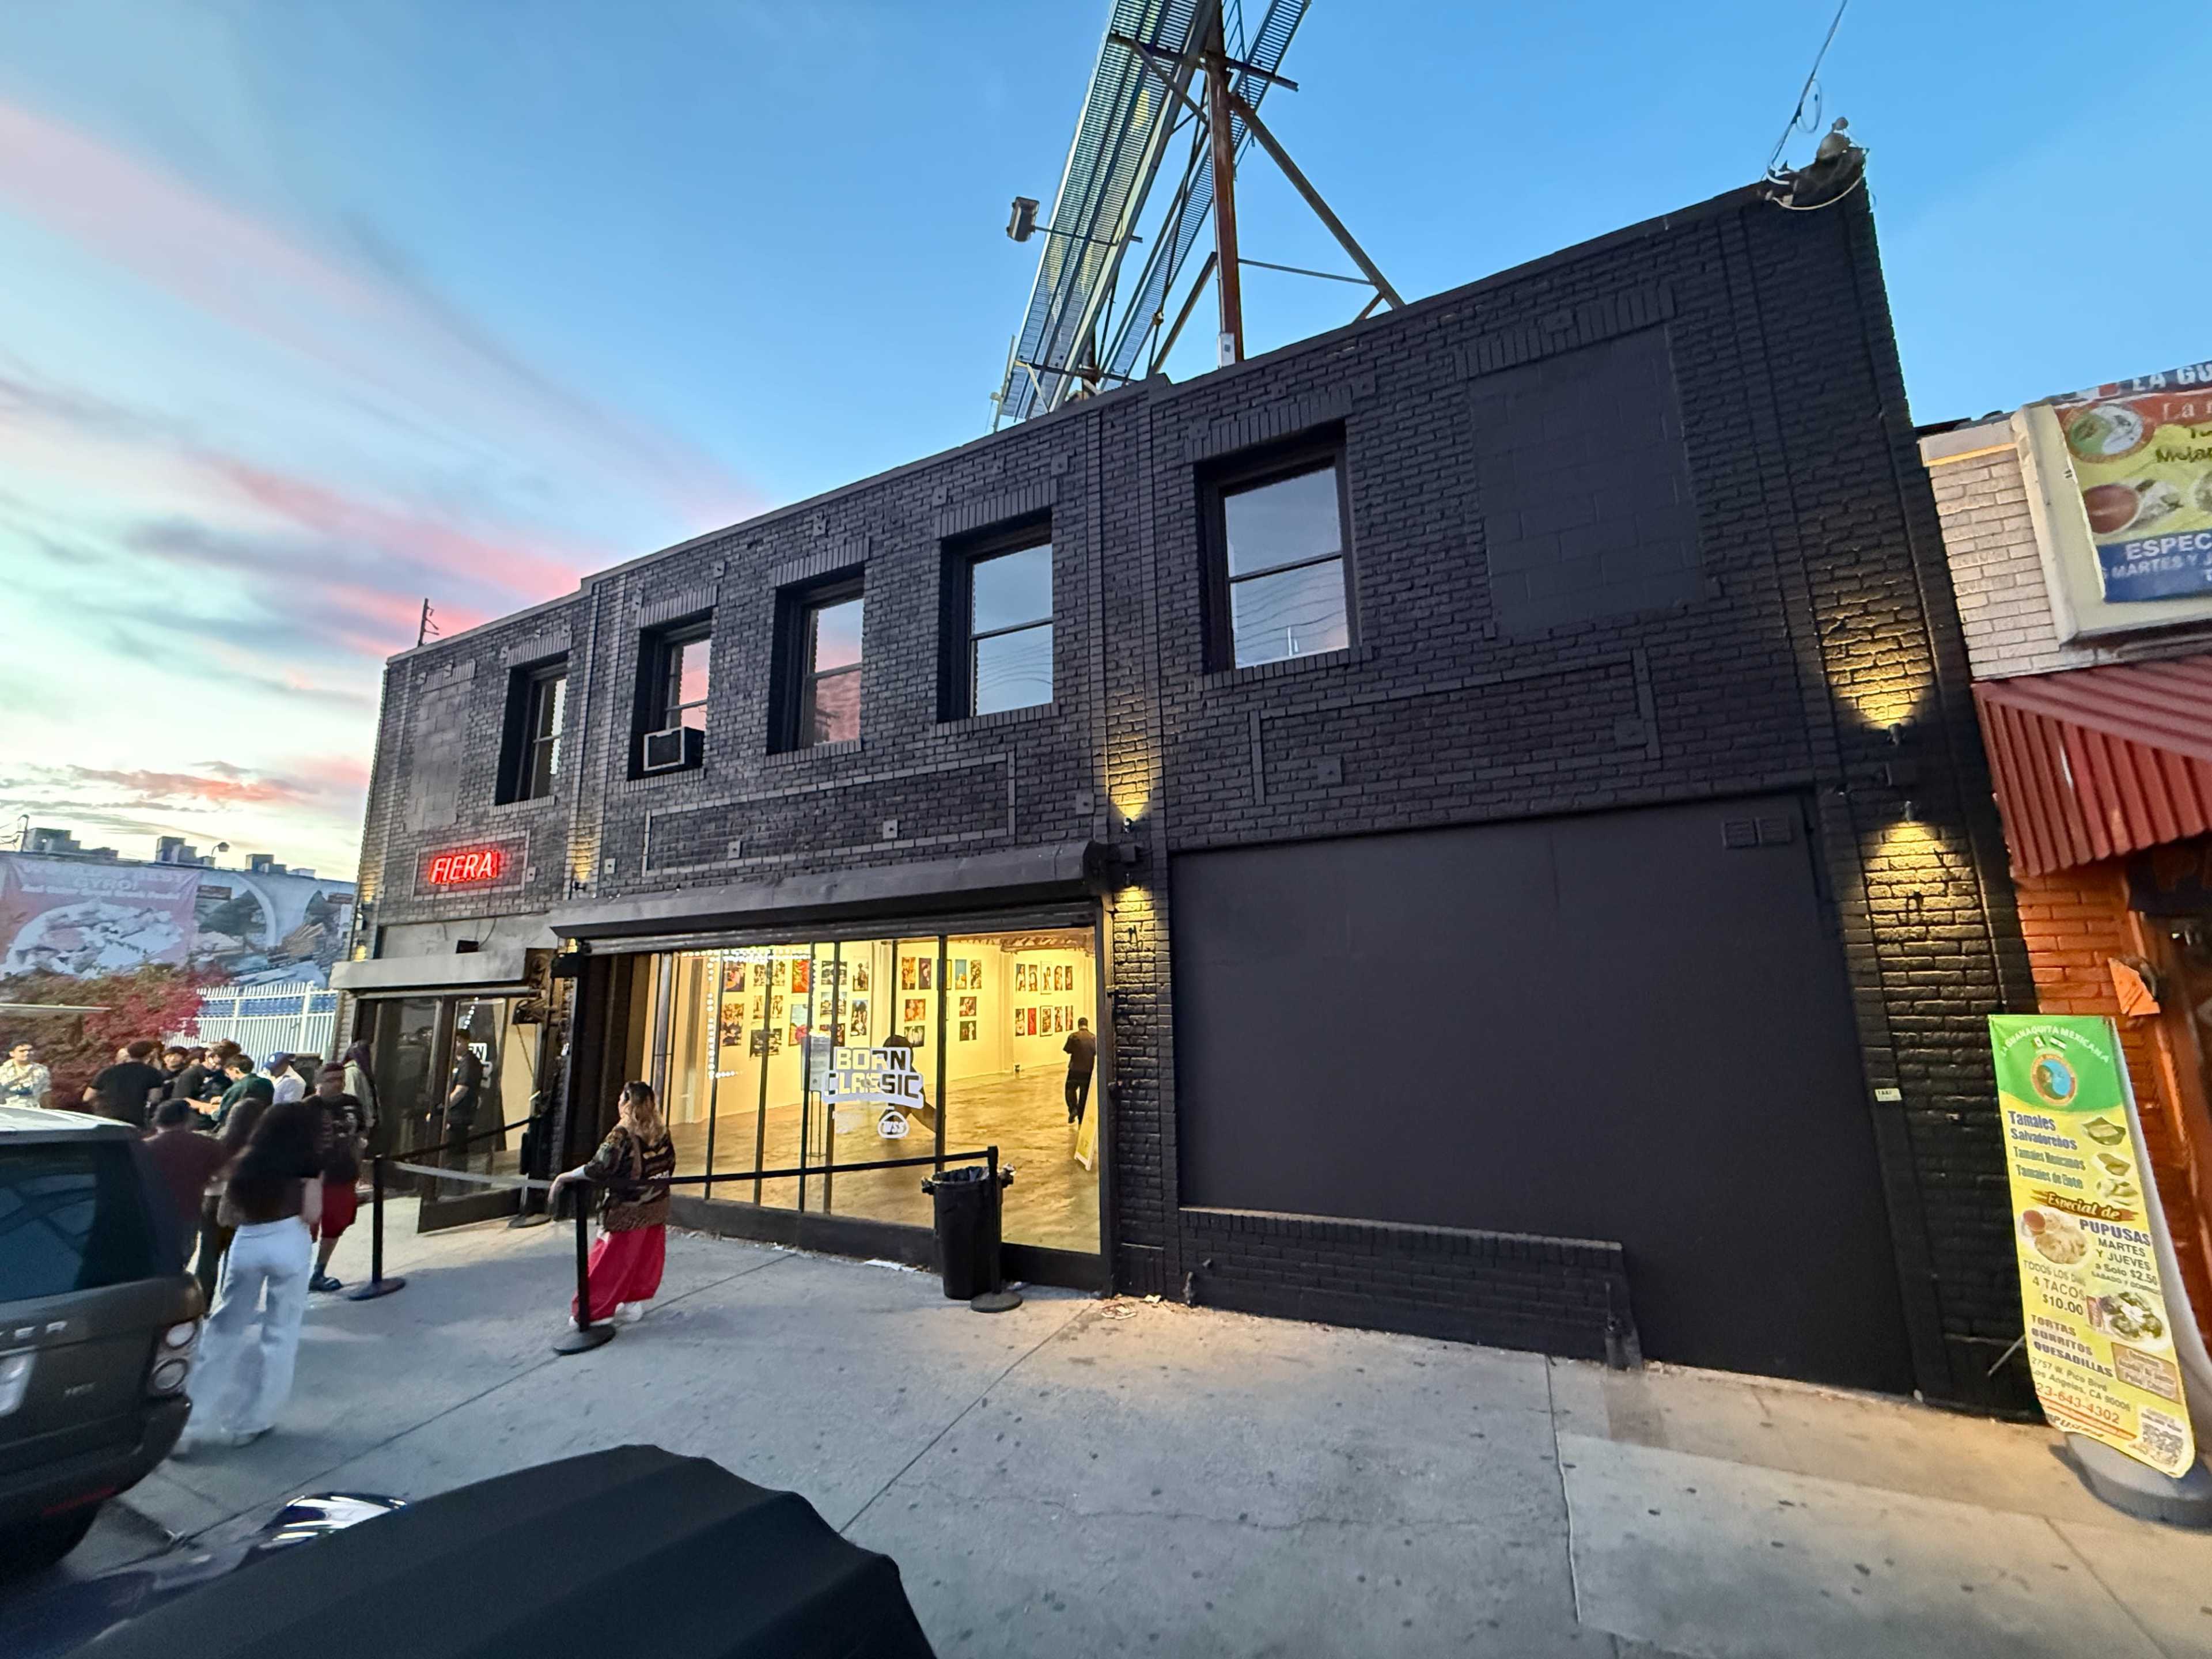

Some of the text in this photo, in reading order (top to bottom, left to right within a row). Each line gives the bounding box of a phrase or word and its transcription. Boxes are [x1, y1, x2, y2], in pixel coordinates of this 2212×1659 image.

[2133, 372, 2166, 391] LA
[2125, 532, 2212, 561] ESPEC
[2111, 554, 2184, 578] MARTES
[429, 851, 497, 884] FIERA
[2060, 1026, 2110, 1063] MEXICANA
[835, 1048, 906, 1071] BORN
[827, 1071, 921, 1100] CLASSIC
[2008, 1110, 2056, 1131] Tamales
[2047, 1192, 2120, 1219] Especial de
[2079, 1218, 2151, 1246] PUPUSAS
[2098, 1237, 2146, 1257] MARTES
[2023, 1259, 2052, 1275] TODOS
[2054, 1269, 2069, 1281] LOS
[2096, 1249, 2152, 1271] Y JUEVES
[2103, 1263, 2127, 1277] Solo
[2130, 1269, 2158, 1286] $2.50
[2032, 1275, 2086, 1301] 4 TACOS
[2042, 1293, 2084, 1316] $10.00
[2031, 1314, 2076, 1336] TORTAS
[2031, 1327, 2093, 1355] BURRITOS
[2033, 1341, 2114, 1377] QUESADILLAS
[2067, 1370, 2085, 1383] Pico
[2089, 1389, 2102, 1400] CA
